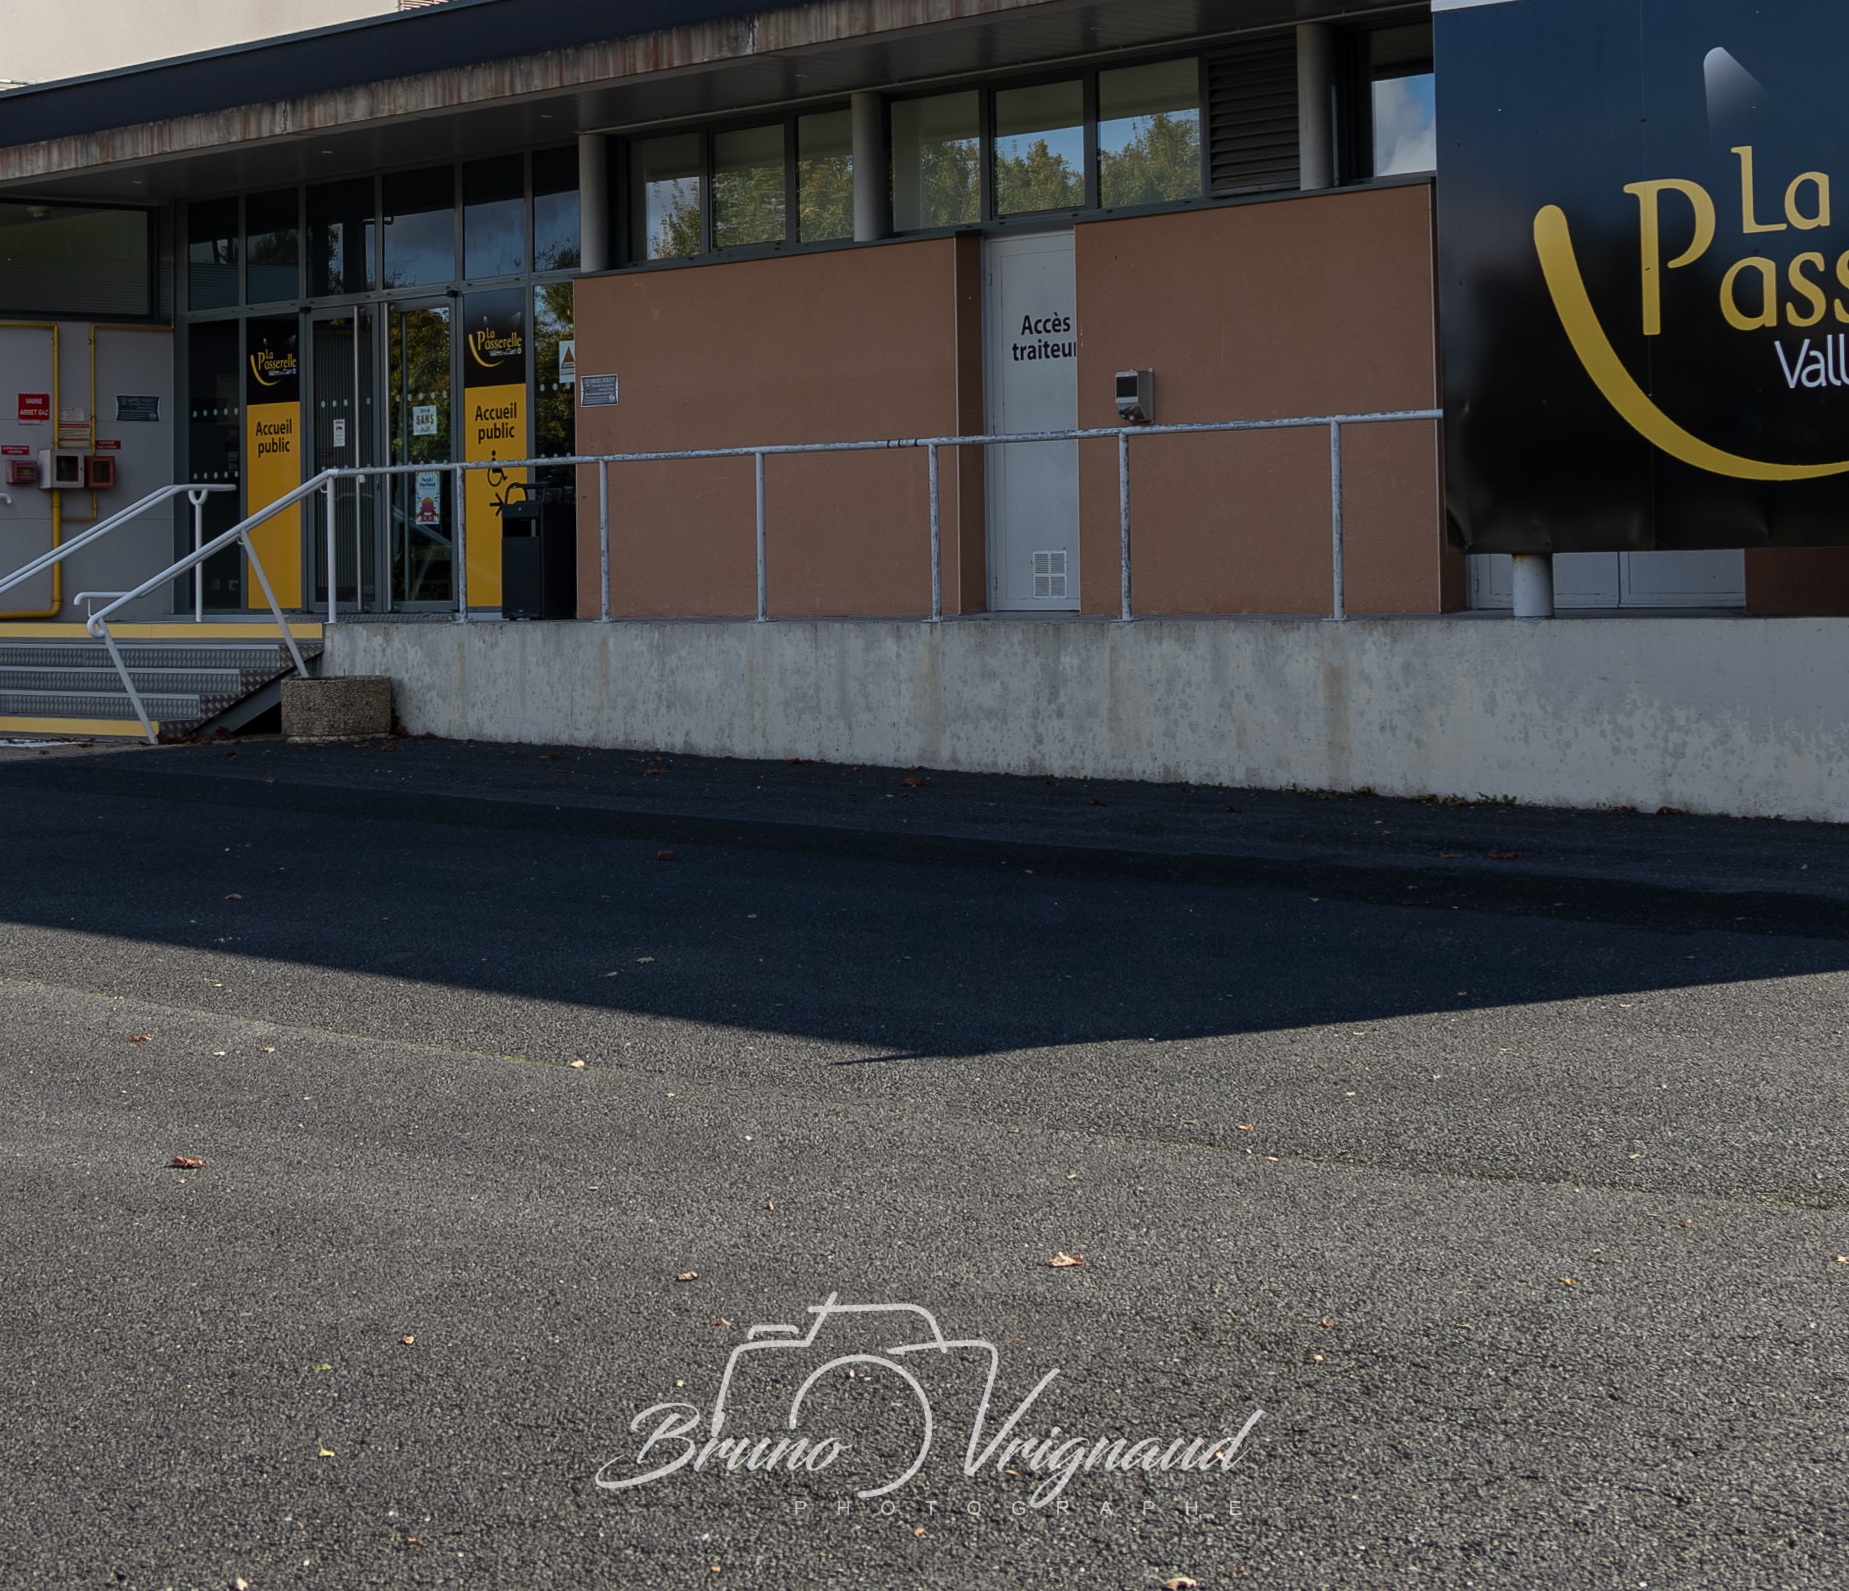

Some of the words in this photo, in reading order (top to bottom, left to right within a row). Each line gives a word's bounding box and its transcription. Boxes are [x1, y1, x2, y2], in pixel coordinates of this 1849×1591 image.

[1731, 145, 1831, 234] La
[1021, 311, 1071, 336] Accès
[475, 402, 517, 421] Accueil
[256, 419, 292, 436] Accueil
[478, 422, 515, 444] public
[258, 437, 290, 458] public
